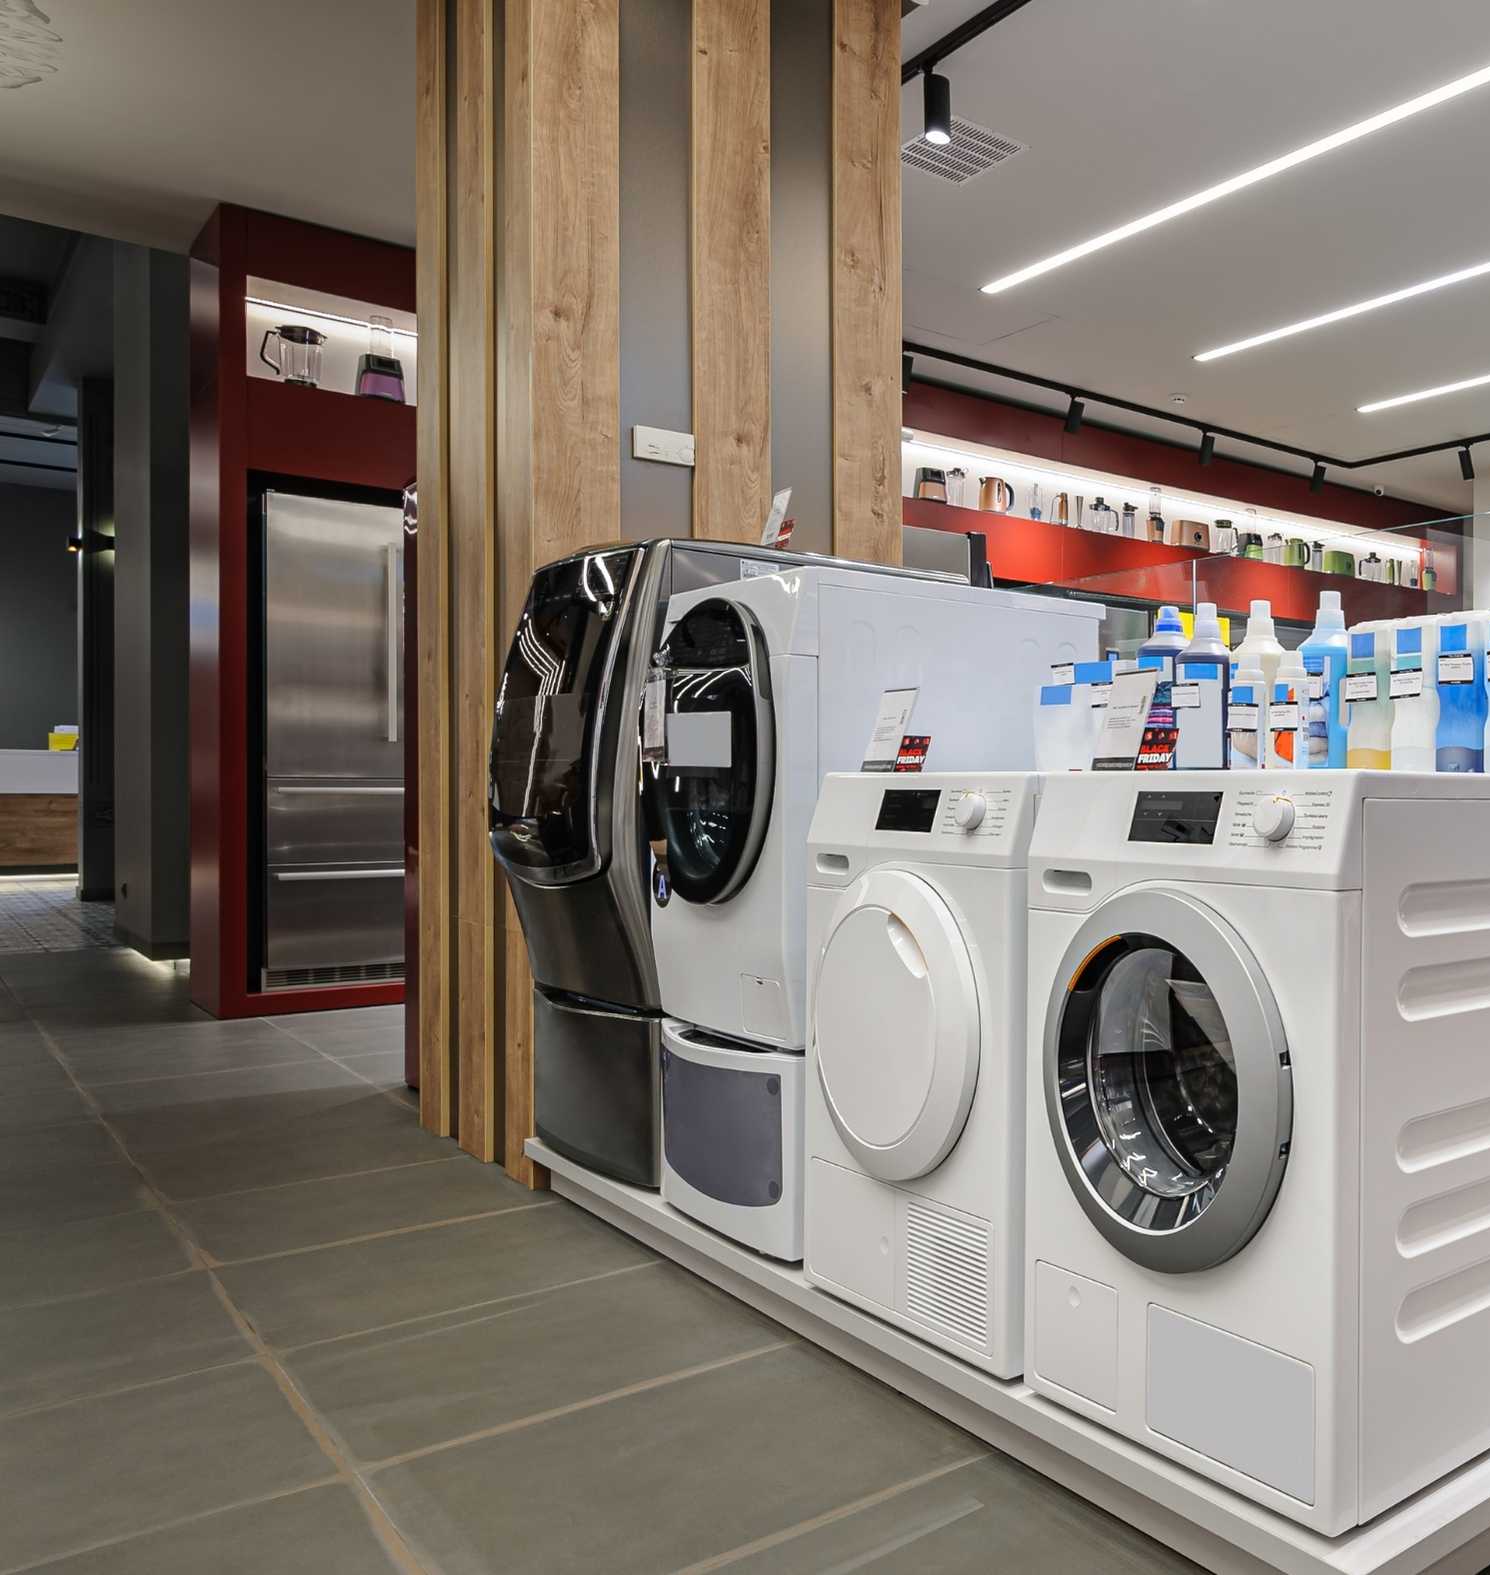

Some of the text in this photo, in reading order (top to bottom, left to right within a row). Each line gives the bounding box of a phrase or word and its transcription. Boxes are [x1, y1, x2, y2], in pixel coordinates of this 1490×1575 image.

[1141, 744, 1169, 753] BLACK
[897, 755, 926, 764] FRIDAY
[1138, 753, 1172, 763] FRIDAY
